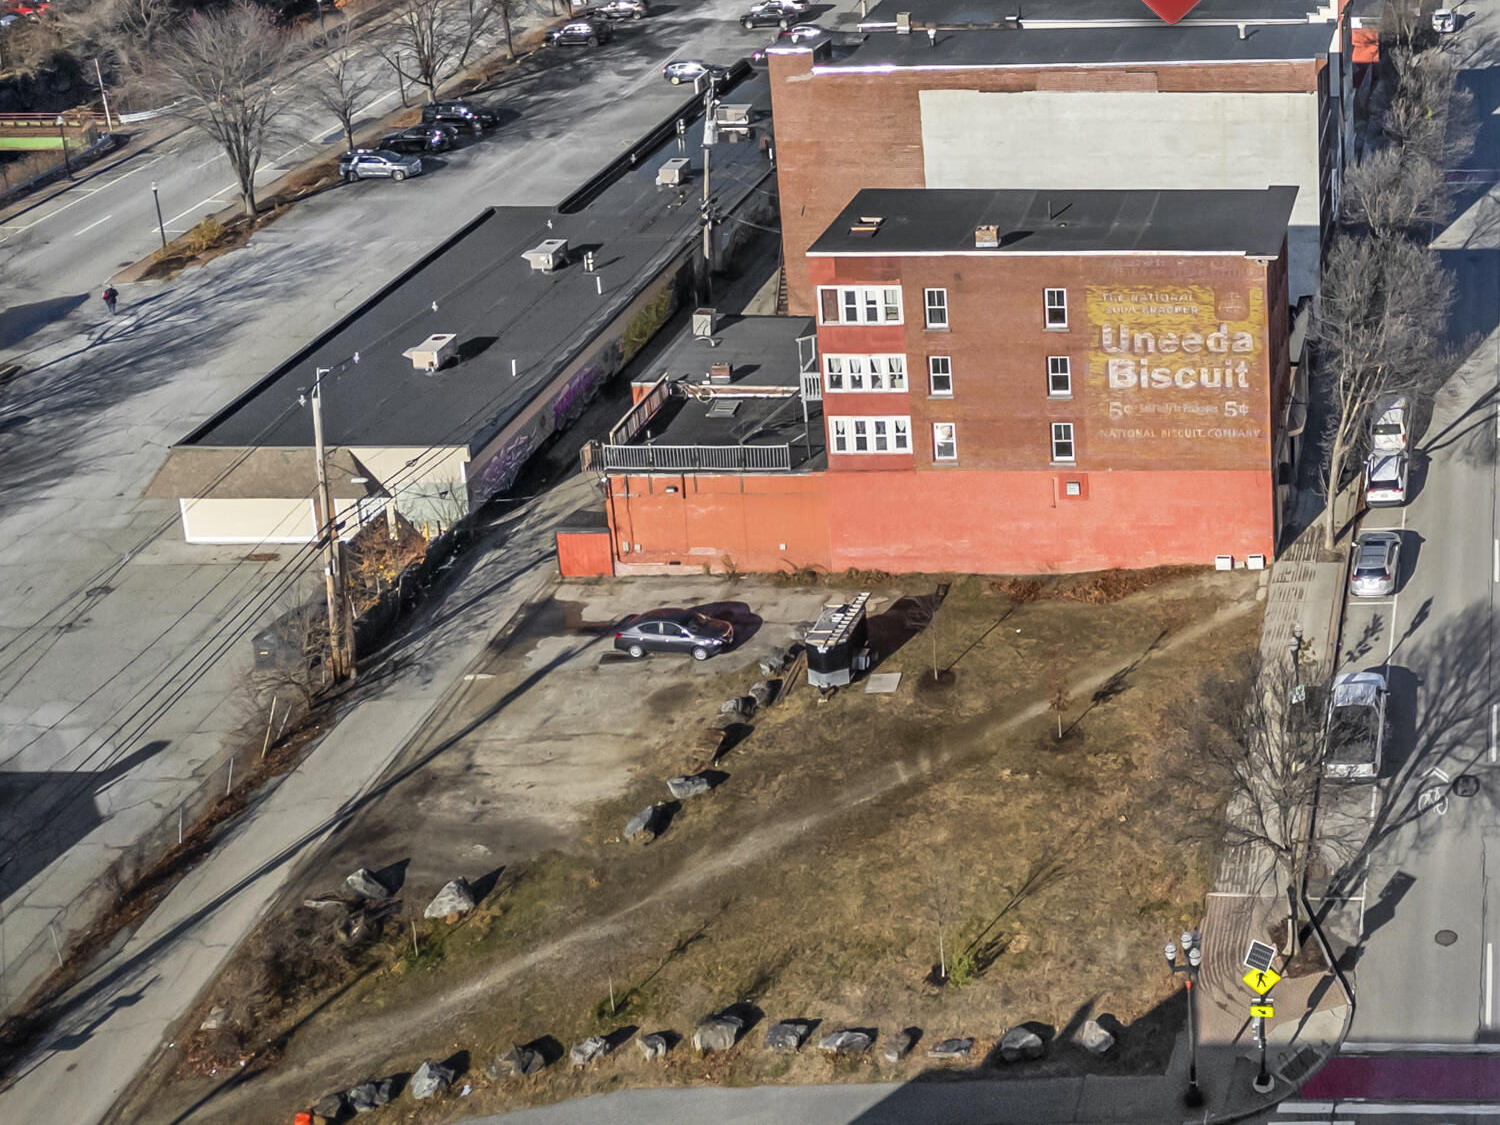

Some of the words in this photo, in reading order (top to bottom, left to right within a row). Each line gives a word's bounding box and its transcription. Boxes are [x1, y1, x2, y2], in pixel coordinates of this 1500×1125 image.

[1102, 323, 1254, 353] Uneeda
[1108, 358, 1249, 389] Biscuit
[1099, 429, 1156, 439] NATIONAL
[1206, 428, 1262, 438] COMPANY
